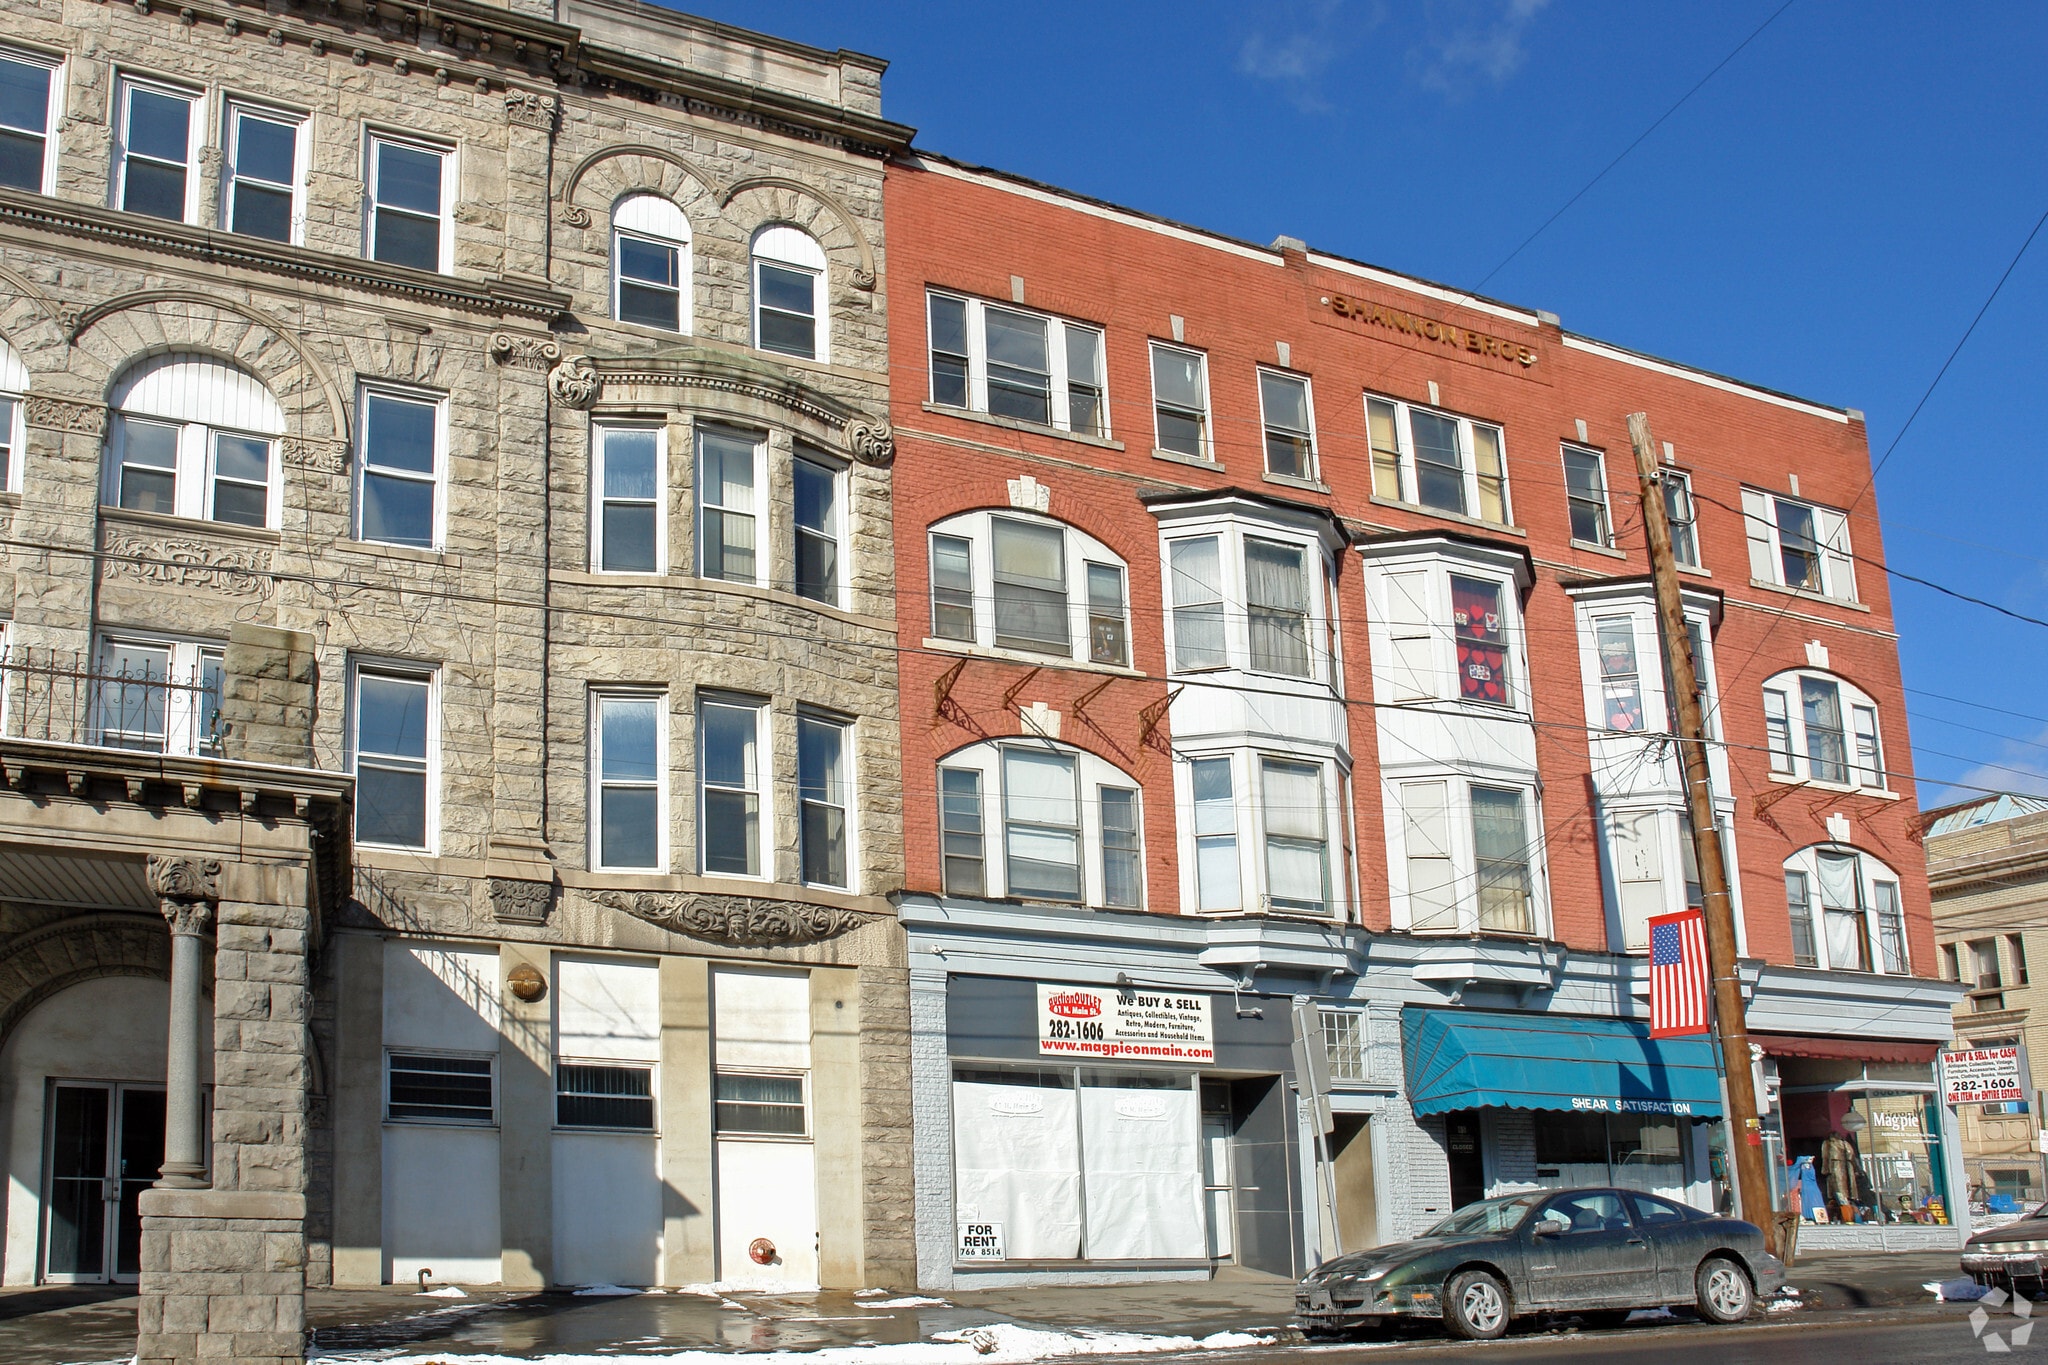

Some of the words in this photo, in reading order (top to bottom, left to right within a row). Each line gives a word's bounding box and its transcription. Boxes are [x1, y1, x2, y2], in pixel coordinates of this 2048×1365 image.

[1332, 295, 1458, 348] SHANNON
[1465, 330, 1532, 368] BROS
[1117, 995, 1134, 1006] We
[1138, 996, 1160, 1007] BUY
[1164, 998, 1172, 1008] &
[1177, 999, 1201, 1010] SELL
[1053, 1005, 1062, 1013] 61
[1072, 1006, 1088, 1015] Main
[1117, 1009, 1144, 1019] Antiques,
[1145, 1011, 1177, 1021] Collectibles,
[1179, 1013, 1201, 1023] Vintage,
[1049, 1019, 1104, 1041] 282-1606
[1126, 1019, 1143, 1028] Retro,
[1144, 1021, 1167, 1030] Modern,
[1168, 1022, 1195, 1032] Furniture,
[1115, 1029, 1146, 1038] Accessories
[1160, 1031, 1189, 1040] Household
[1190, 1033, 1205, 1041] Items
[1041, 1039, 1213, 1058] www.magpieonmain.com
[1944, 1053, 1953, 1063] We
[1955, 1052, 1967, 1062] BUY
[1968, 1052, 1974, 1060] &
[1974, 1050, 1988, 1060] SELL
[1989, 1049, 1998, 1059] for
[2000, 1047, 2017, 1058] CASH
[1953, 1078, 2015, 1091] 282-1606
[1948, 1092, 1959, 1102] ONE
[1960, 1091, 1973, 1101] ITEM
[1974, 1092, 1981, 1100] or
[1981, 1089, 2000, 1100] ENTIRE
[2001, 1088, 2022, 1099] ESTATES
[1571, 1097, 1608, 1110] SHEAR
[1615, 1100, 1691, 1114] SATISFACTION
[1873, 1111, 1920, 1131] Magpie
[968, 1225, 992, 1235] FOR
[964, 1236, 997, 1247] RENT
[960, 1248, 976, 1256] 766
[981, 1248, 1001, 1256] 8514
